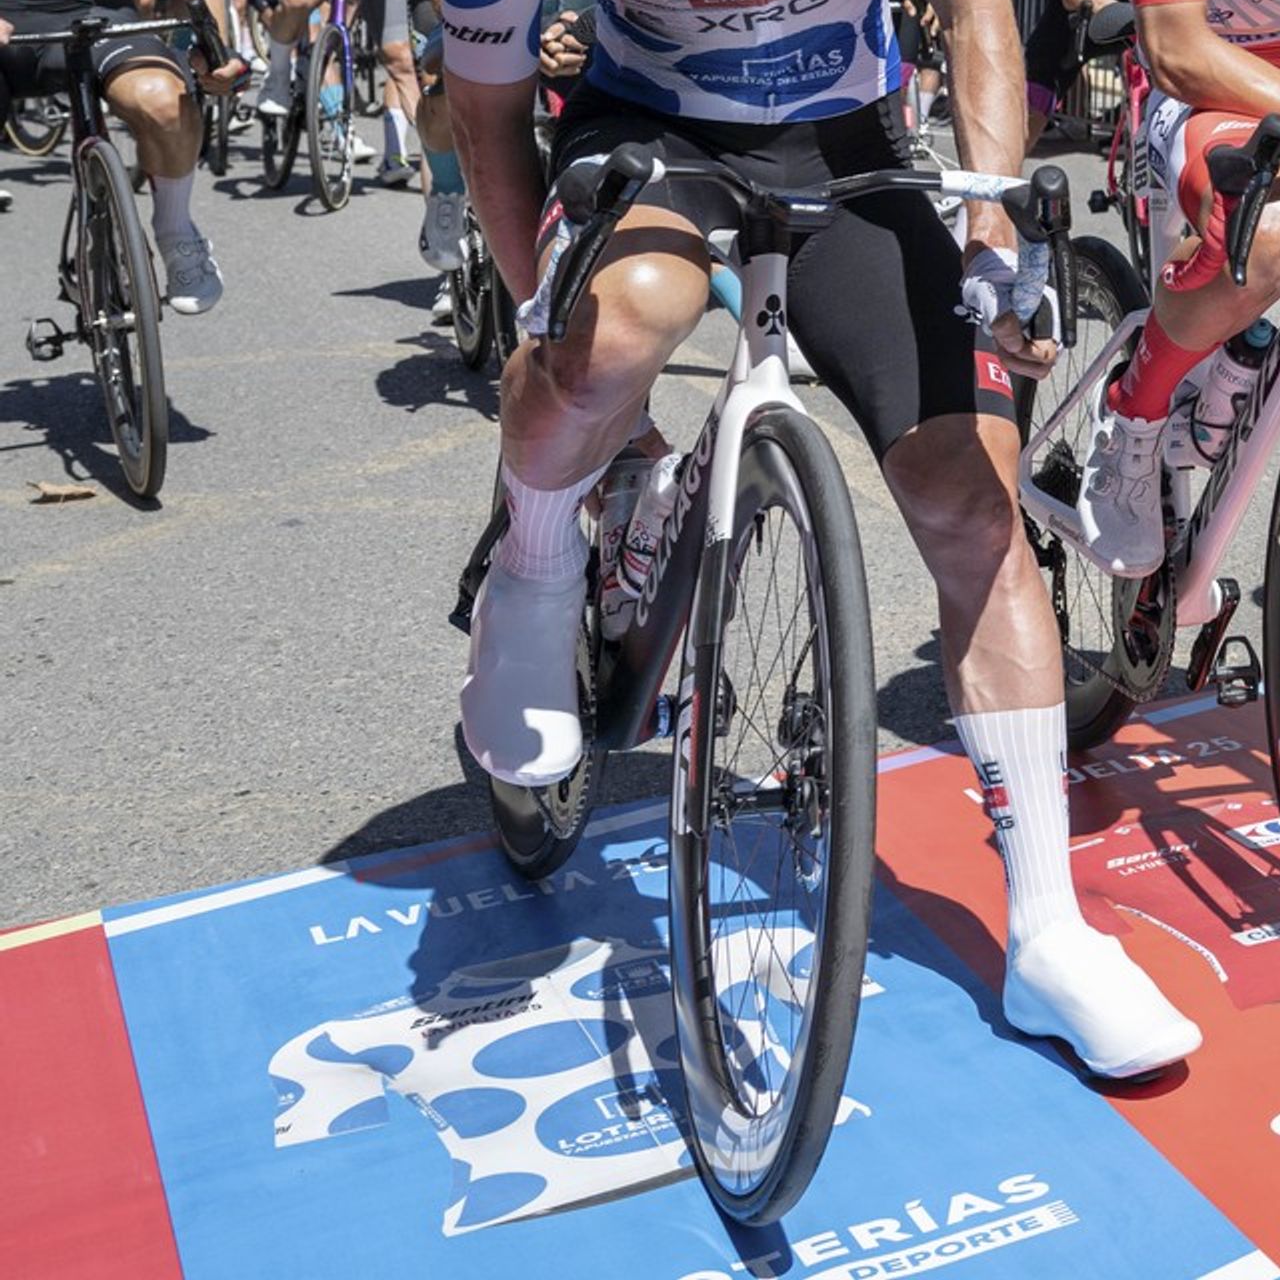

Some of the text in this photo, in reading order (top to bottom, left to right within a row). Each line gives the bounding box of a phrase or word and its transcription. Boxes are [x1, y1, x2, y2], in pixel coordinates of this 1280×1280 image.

[1186, 736, 1243, 758] 25
[309, 915, 382, 945] LA
[557, 1113, 673, 1152] LOTER
[674, 1172, 1051, 1280] TERÍAS
[847, 1213, 1040, 1280] DEPORTE
